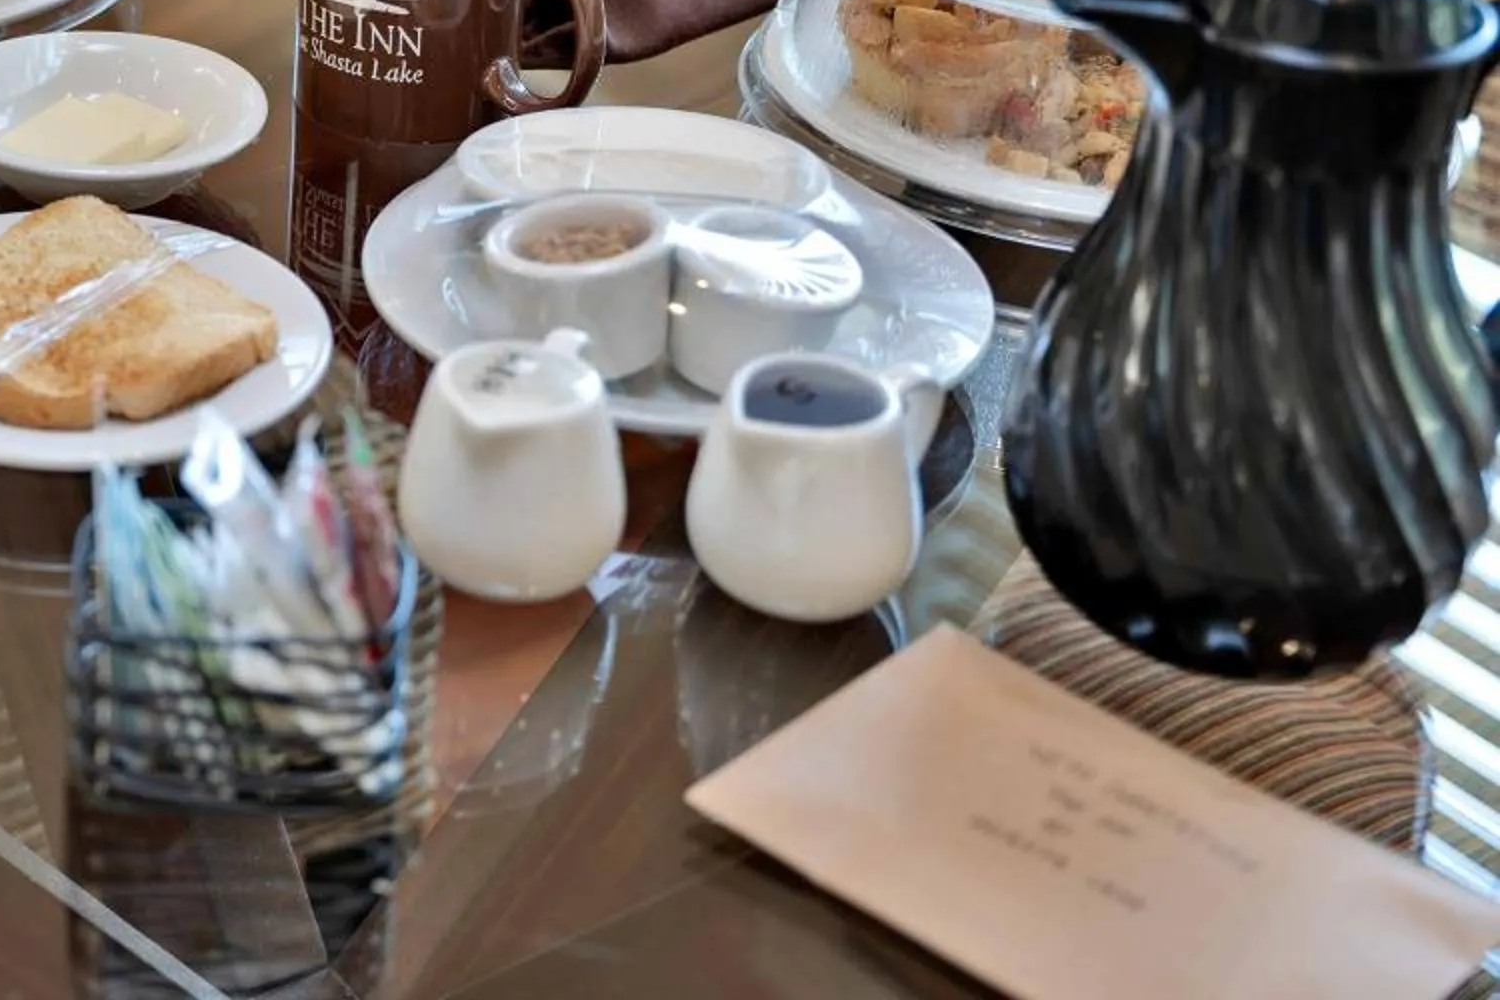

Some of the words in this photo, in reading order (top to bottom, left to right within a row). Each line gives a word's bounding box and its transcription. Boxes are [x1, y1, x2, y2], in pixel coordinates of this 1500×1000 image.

[353, 11, 423, 57] INN
[311, 36, 363, 77] Shasta
[371, 58, 424, 84] Lake
